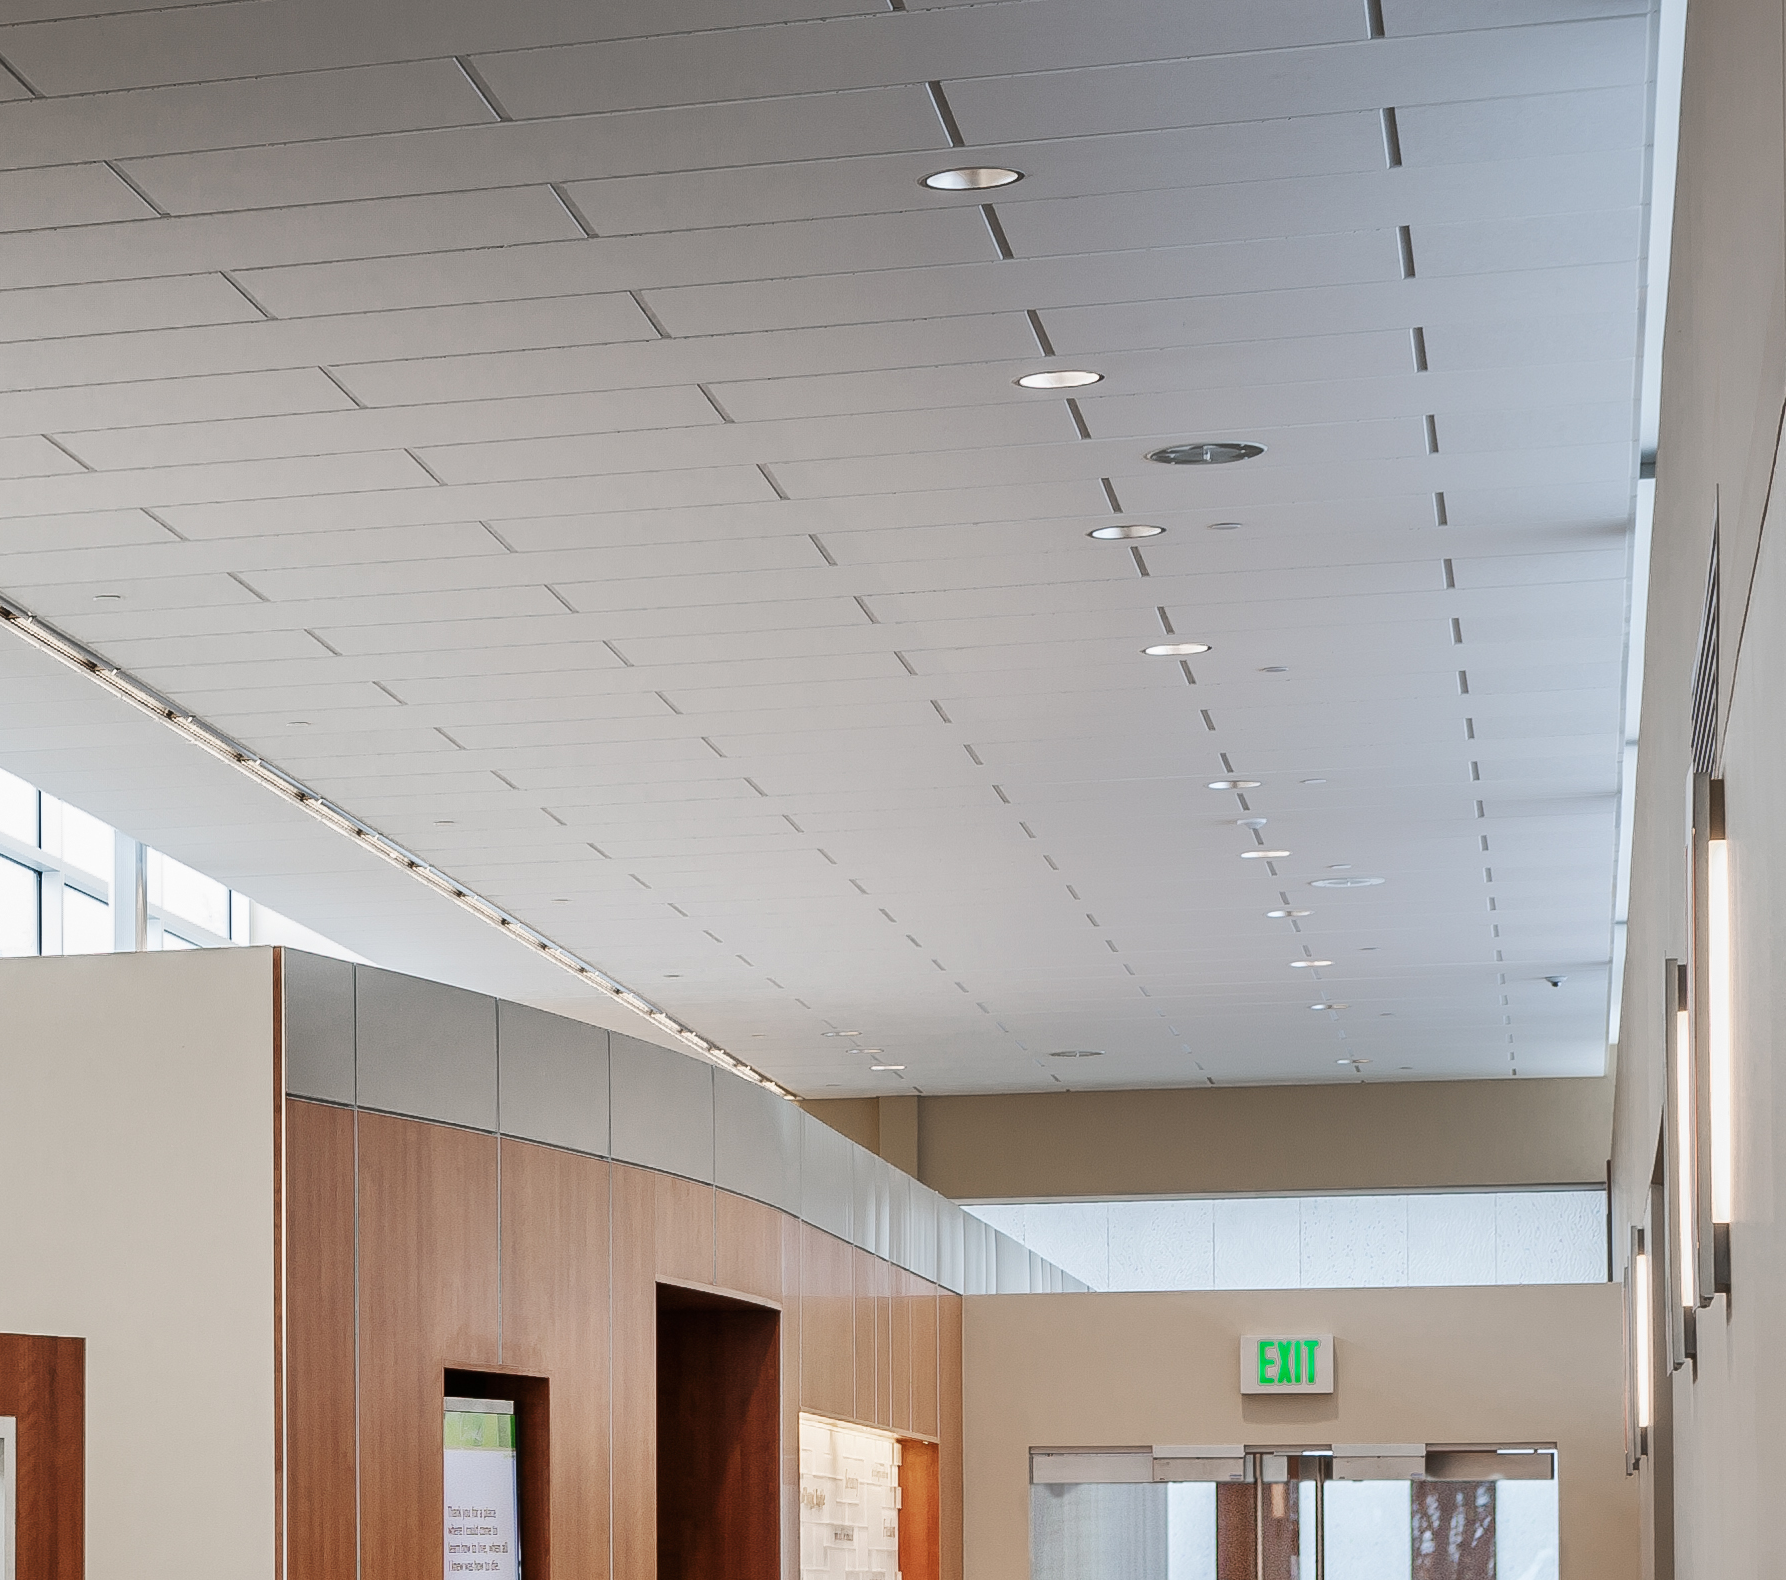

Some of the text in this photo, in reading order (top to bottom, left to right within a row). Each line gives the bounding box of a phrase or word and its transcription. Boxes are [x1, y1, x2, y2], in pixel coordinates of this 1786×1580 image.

[1258, 1340, 1320, 1385] EXIT
[447, 1505, 462, 1518] Thank
[462, 1509, 471, 1520] you
[471, 1506, 479, 1518] for
[483, 1507, 497, 1521] place
[447, 1524, 463, 1536] where
[492, 1525, 499, 1536] to
[471, 1543, 477, 1554] to
